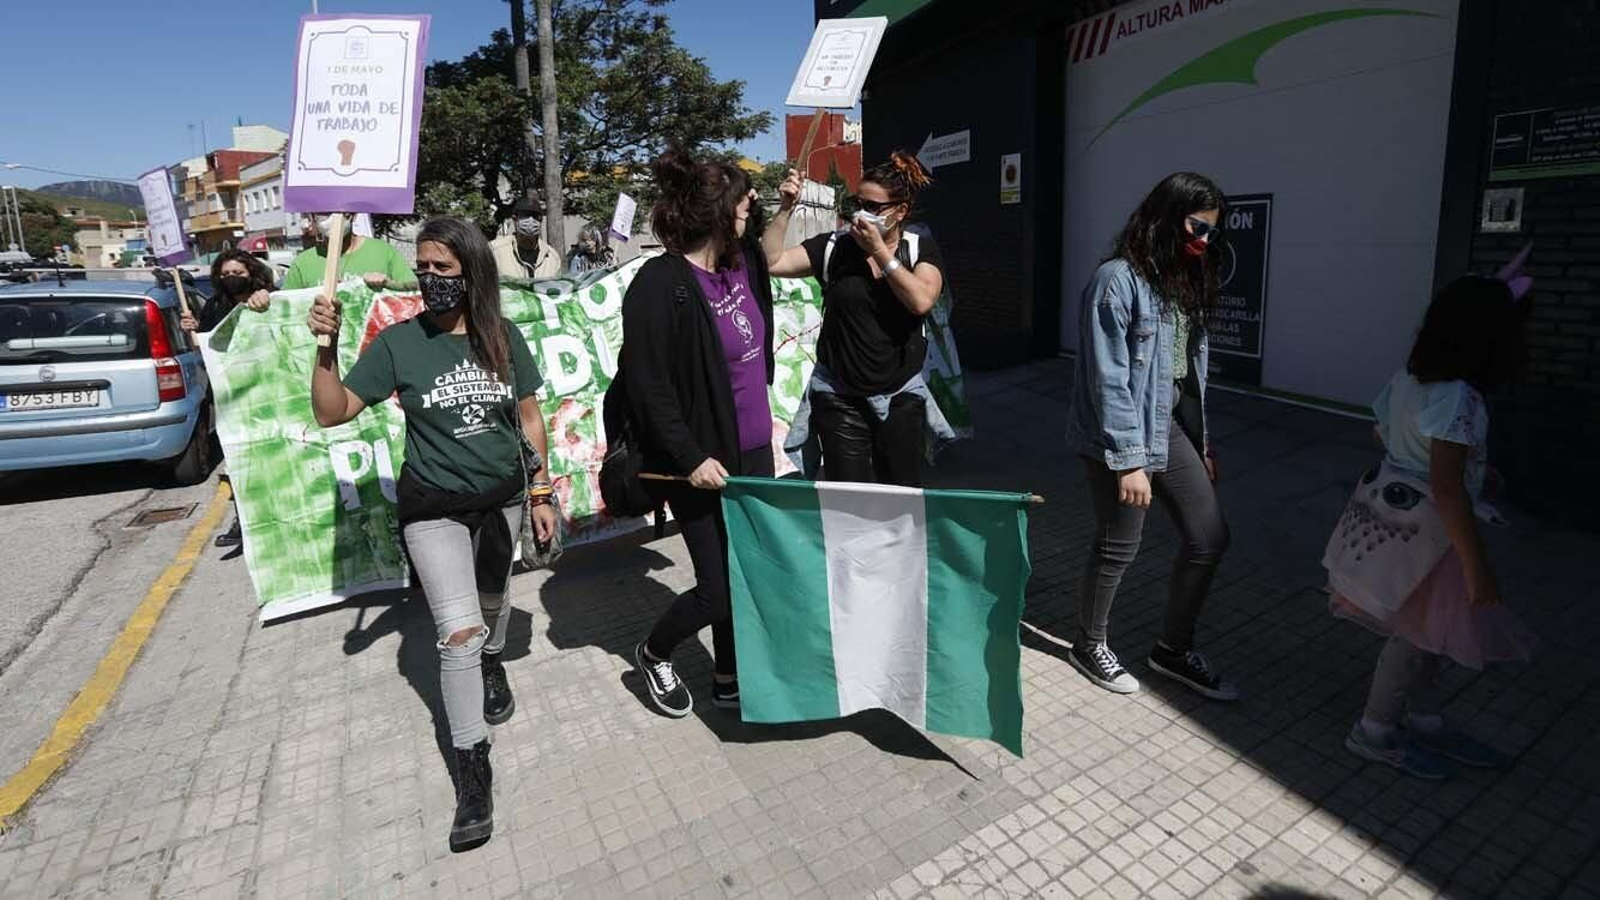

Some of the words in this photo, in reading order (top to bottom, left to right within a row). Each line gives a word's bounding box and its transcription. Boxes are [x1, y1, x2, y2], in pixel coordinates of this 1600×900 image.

[1117, 2, 1184, 39] ALTURA
[333, 66, 347, 74] DE
[351, 66, 384, 74] MAYO
[331, 83, 368, 97] TODA
[307, 101, 331, 115] UNA
[338, 101, 371, 114] VIDA
[379, 101, 399, 115] DE
[316, 118, 378, 132] TRABAJO
[437, 388, 450, 398] EL
[453, 383, 501, 395] SISTEMA
[10, 392, 55, 406] 8753
[60, 390, 93, 404] FBY
[439, 398, 457, 409] NO
[458, 395, 470, 404] EL
[471, 394, 502, 403] CLIMA
